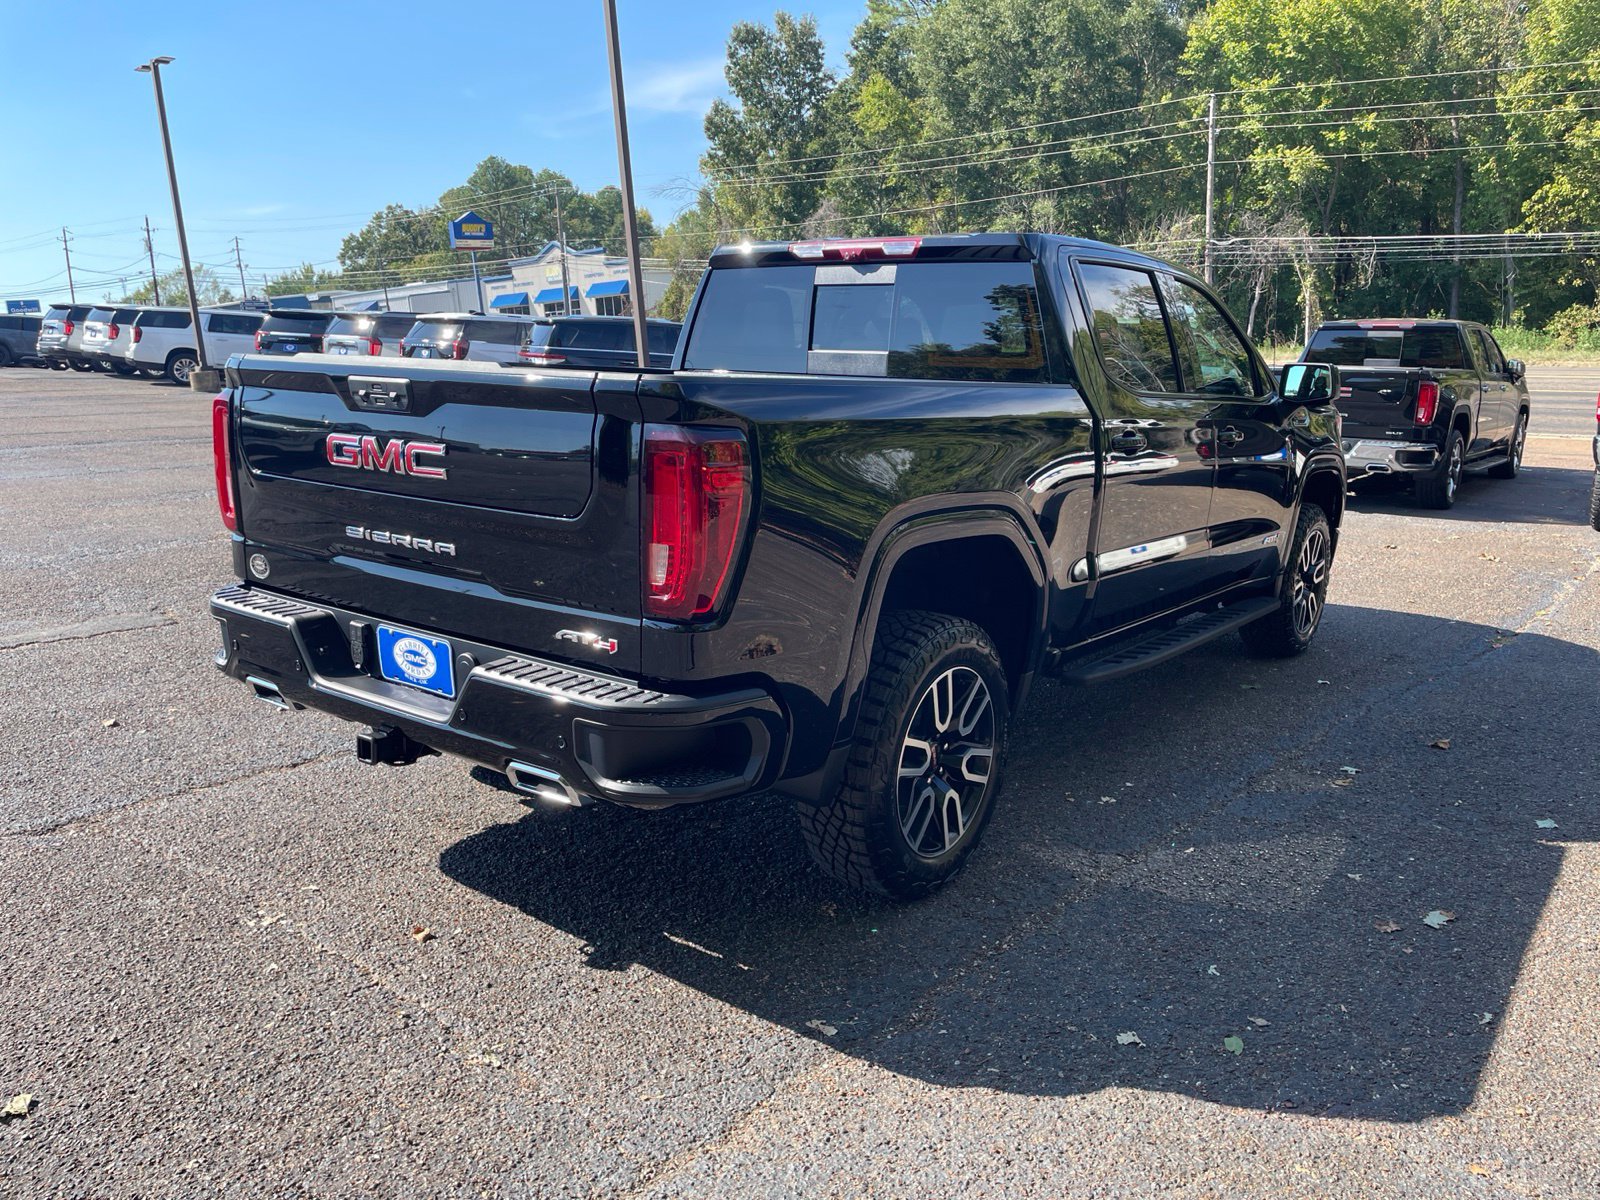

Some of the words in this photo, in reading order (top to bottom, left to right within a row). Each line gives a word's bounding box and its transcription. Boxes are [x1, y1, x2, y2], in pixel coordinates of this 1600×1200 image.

[326, 433, 448, 480] GMC
[345, 525, 457, 557] SIERRA
[554, 629, 619, 655] AT4
[403, 652, 427, 666] GMC
